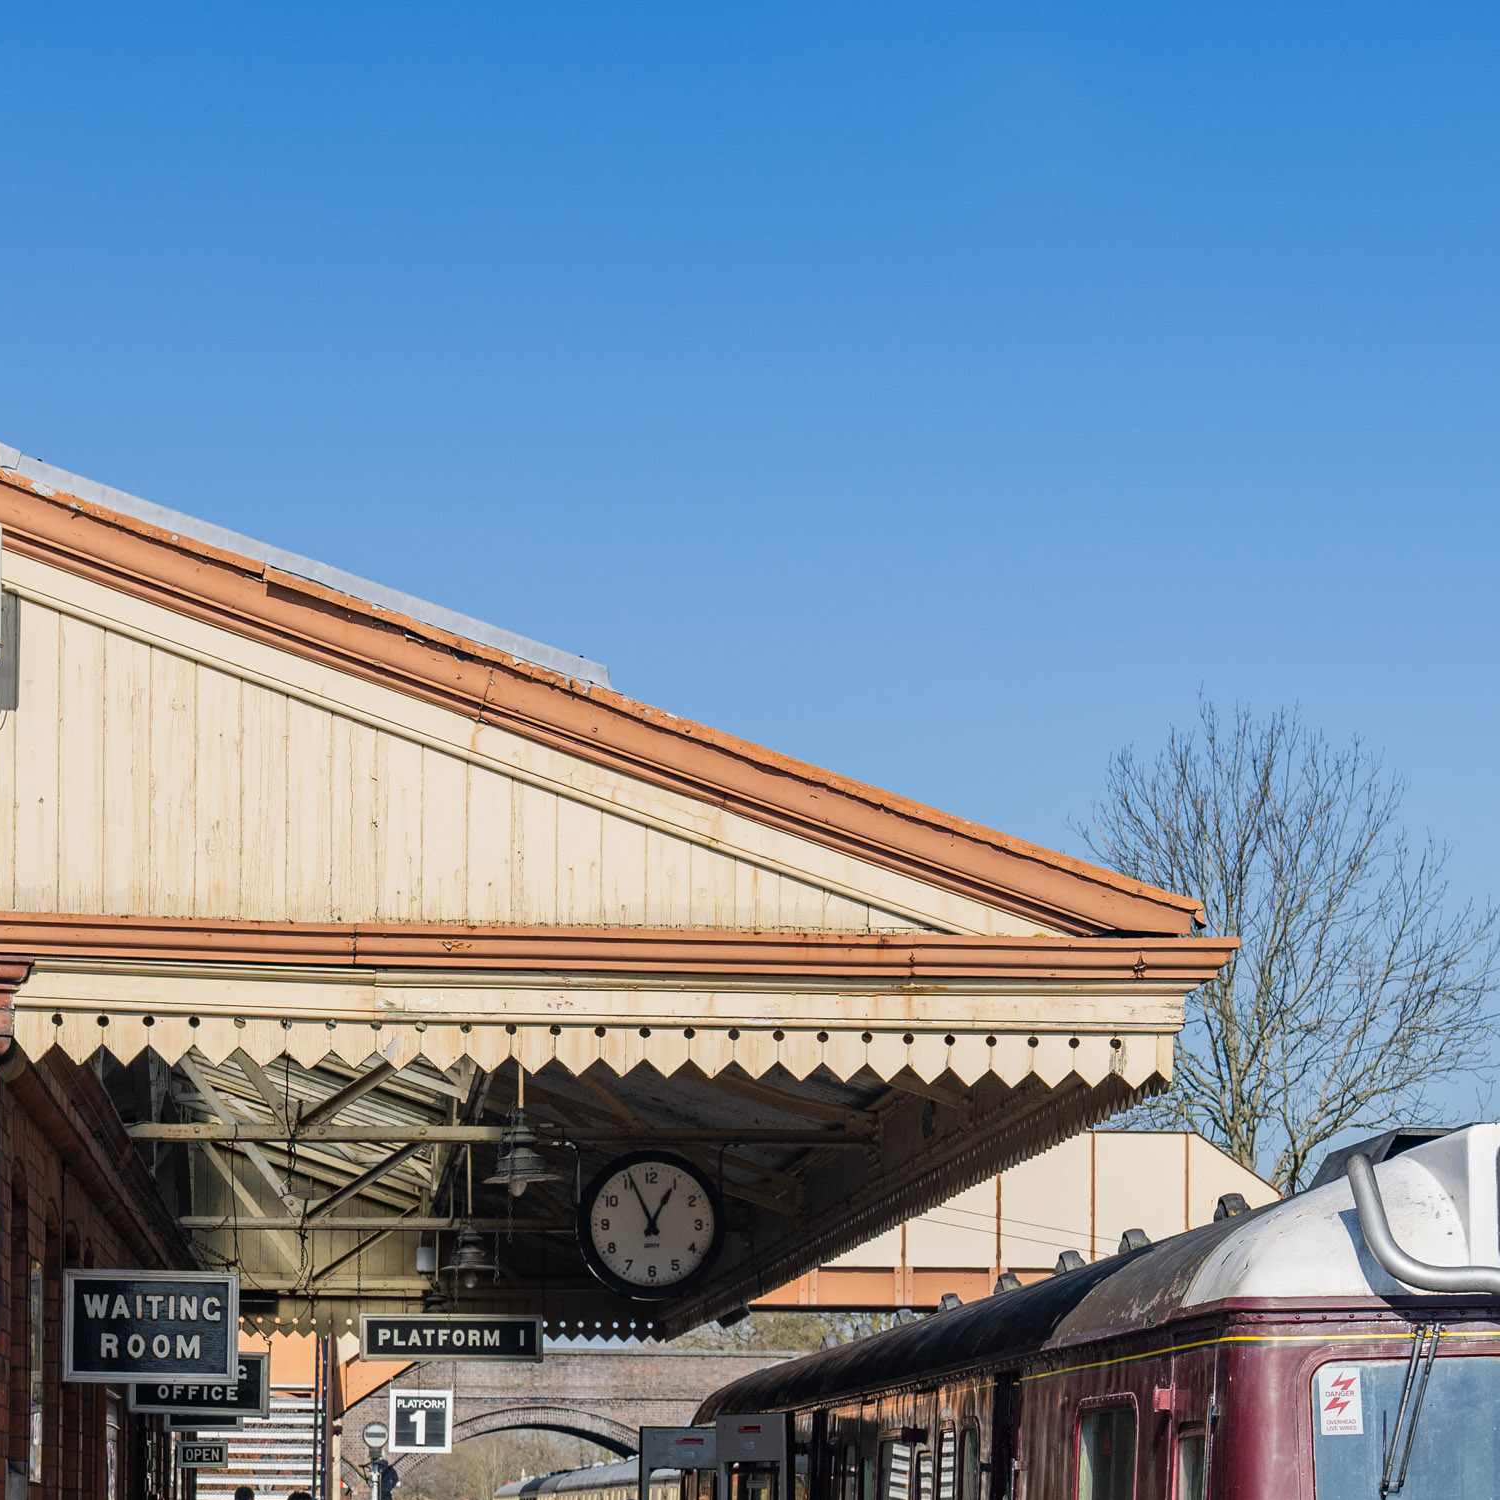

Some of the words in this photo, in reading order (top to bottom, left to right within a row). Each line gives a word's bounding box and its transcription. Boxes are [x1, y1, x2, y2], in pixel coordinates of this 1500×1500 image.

[645, 1172, 658, 1184] 12
[605, 1195, 618, 1207] 10
[688, 1195, 697, 1207] 2
[600, 1218, 610, 1231] 9
[694, 1219, 703, 1230] 3
[607, 1242, 616, 1254] 8
[688, 1242, 696, 1253] 4
[624, 1259, 633, 1271] 7
[647, 1265, 657, 1277] 6
[671, 1259, 680, 1271] 5
[83, 1294, 221, 1322] WAITING
[378, 1328, 500, 1347] PLATFORM
[100, 1333, 201, 1359] ROOM
[157, 1385, 239, 1401] OFFICE
[397, 1399, 446, 1409] PLATFORM
[409, 1409, 427, 1445] 1
[185, 1448, 220, 1462] OPEN
